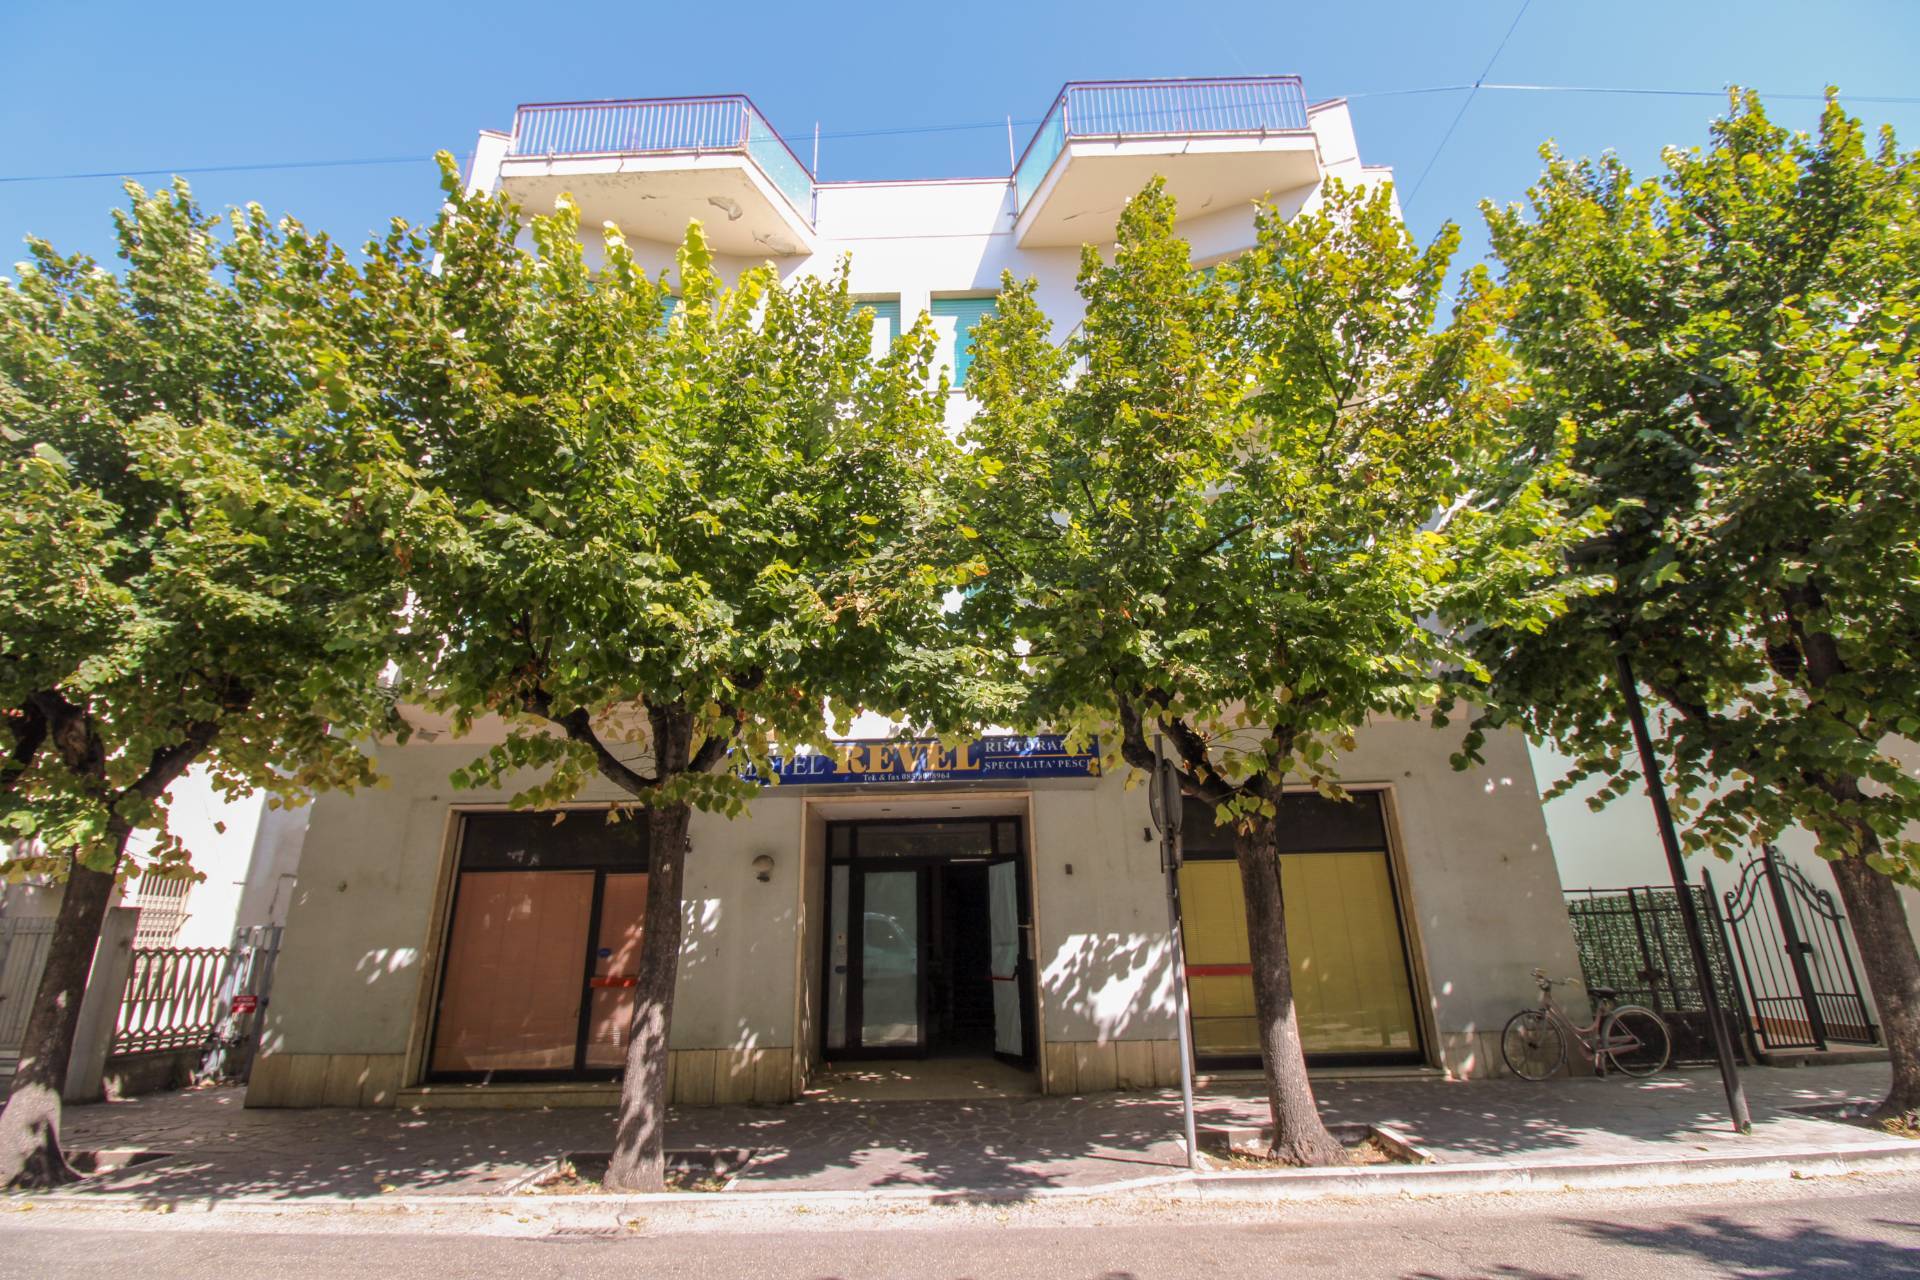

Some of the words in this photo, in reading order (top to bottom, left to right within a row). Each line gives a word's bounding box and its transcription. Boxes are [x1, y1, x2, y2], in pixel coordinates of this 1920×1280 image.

[985, 739, 1092, 753] RISTORA
[738, 754, 825, 776] TEL
[833, 741, 980, 774] REVEL
[888, 772, 900, 781] fax
